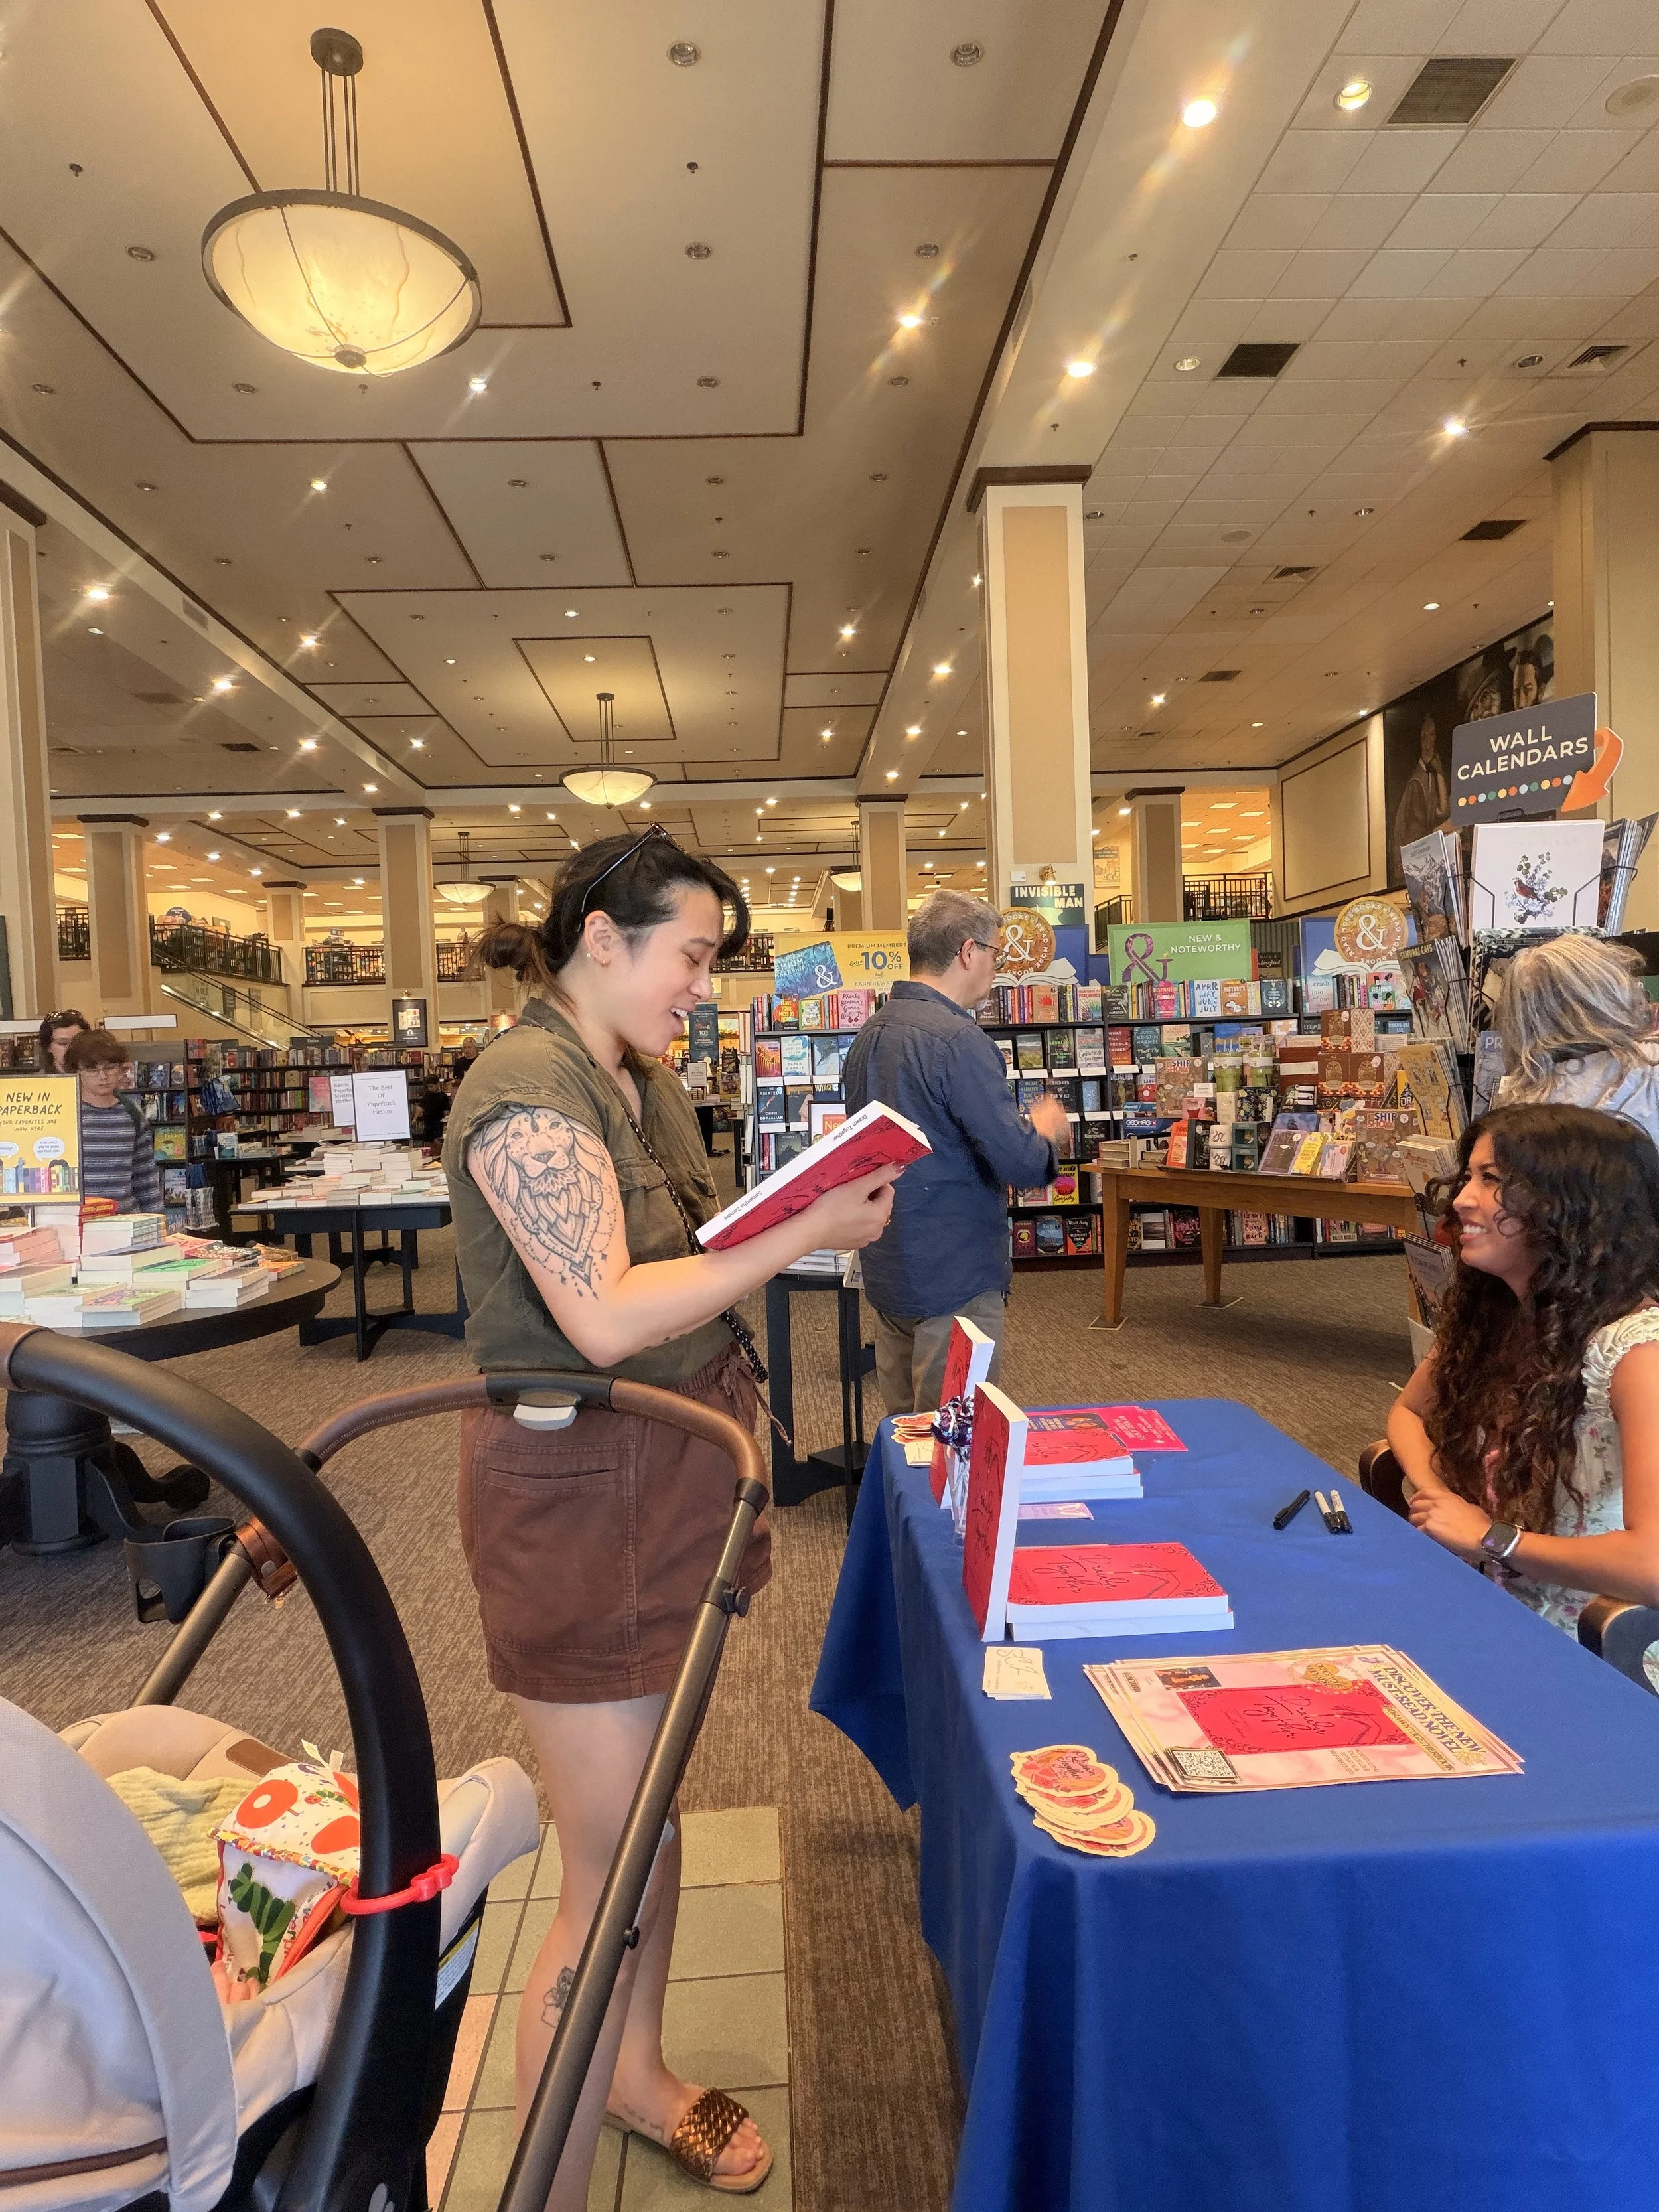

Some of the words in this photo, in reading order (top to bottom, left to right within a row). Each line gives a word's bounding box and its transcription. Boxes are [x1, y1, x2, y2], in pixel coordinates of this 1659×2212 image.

[1490, 725, 1552, 753] WALL
[1457, 737, 1588, 780] CALENDARS
[1015, 886, 1075, 897] INVISIBLE
[1054, 897, 1083, 908] MAN
[1355, 904, 1382, 914] BOOKS
[1342, 913, 1354, 934] MORE
[1389, 912, 1401, 931] READ
[1035, 922, 1048, 943] READ
[1171, 944, 1240, 953] NOTEWORTHY
[1340, 936, 1354, 957] READ
[1400, 948, 1421, 960] SAMURAI
[1421, 944, 1433, 955] CATS
[776, 958, 804, 972] EMIUM
[1035, 947, 1048, 968] MORE
[1485, 1035, 1502, 1049] PR
[6, 1093, 33, 1102] NEW
[38, 1092, 50, 1101] IN
[832, 1122, 854, 1142] Together
[849, 1114, 868, 1130] Drawn
[737, 1190, 763, 1211] Samantha
[723, 1203, 744, 1220] Zamora
[1033, 1554, 1102, 1593] Together
[1242, 1695, 1312, 1739] Together
[1279, 1695, 1335, 1735] Drawn
[1370, 1670, 1427, 1720] MUST-READ
[1423, 1721, 1461, 1754] NOVEL
[1382, 1667, 1437, 1710] DISCOVER
[1429, 1711, 1459, 1731] THE
[1453, 1732, 1485, 1753] NEW
